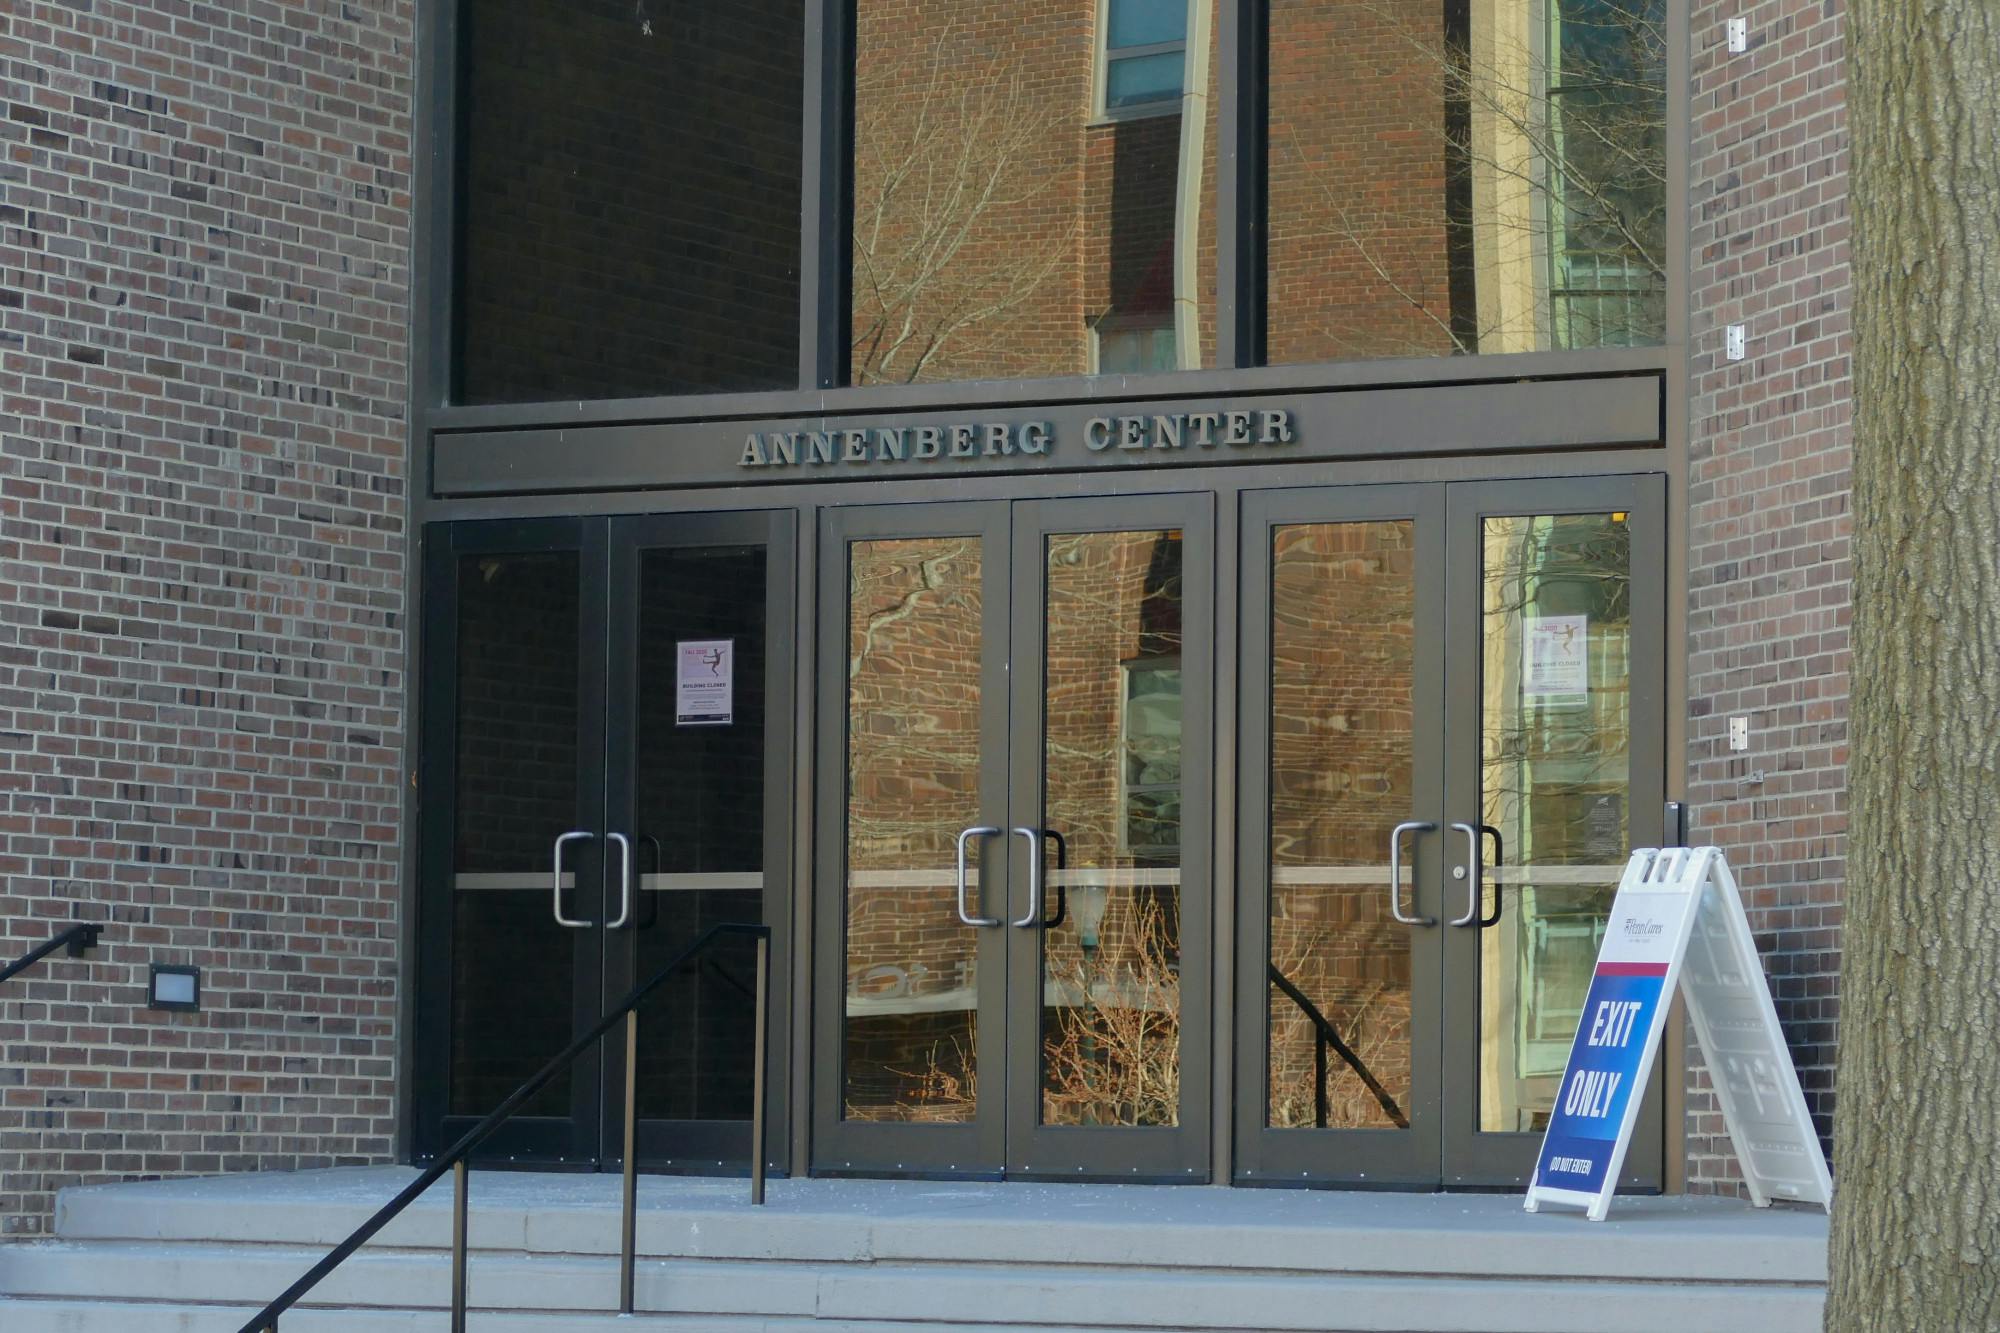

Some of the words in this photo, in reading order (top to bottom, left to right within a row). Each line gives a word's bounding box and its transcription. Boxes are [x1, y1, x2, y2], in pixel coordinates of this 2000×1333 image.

[737, 421, 1053, 467] ANNENBERG
[1082, 409, 1294, 452] CENTER
[1588, 1001, 1642, 1047] EXIT
[1565, 1070, 1622, 1118] ONLY
[1559, 1157, 1574, 1172] NOT
